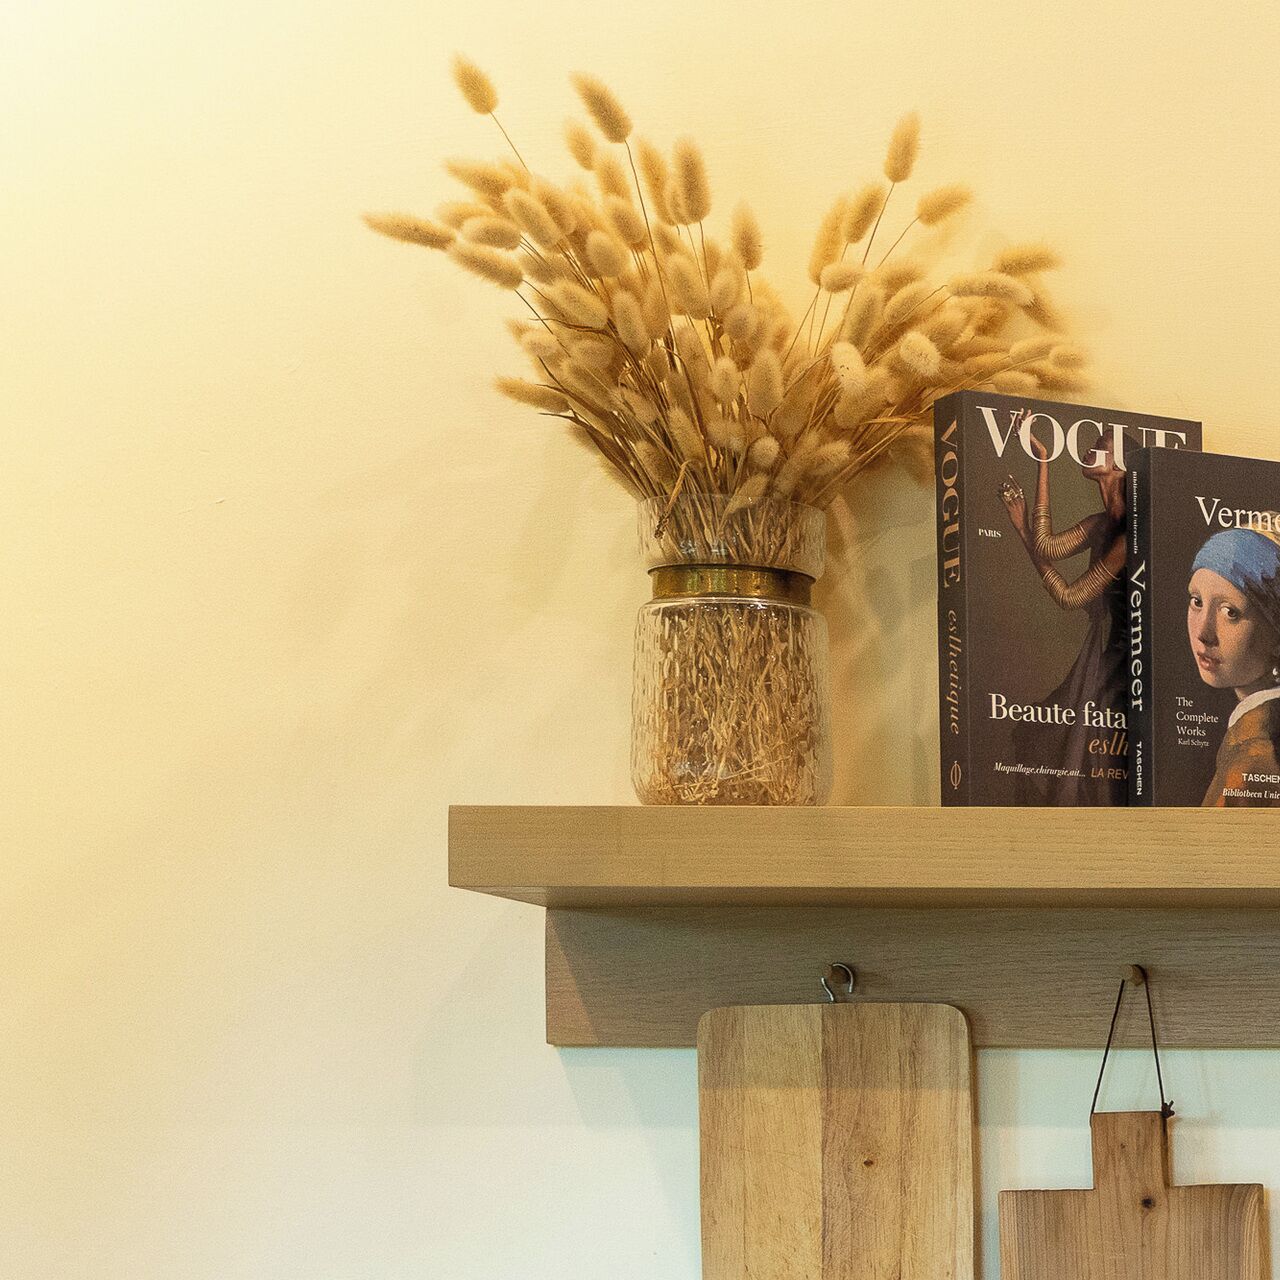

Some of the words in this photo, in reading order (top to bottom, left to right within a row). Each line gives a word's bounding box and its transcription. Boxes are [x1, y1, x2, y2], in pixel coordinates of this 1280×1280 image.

[941, 420, 961, 589] VOGUE
[978, 528, 1002, 540] PARIS
[1129, 560, 1147, 712] Vermeer
[1176, 696, 1194, 708] The
[988, 693, 1076, 726] Beaute
[1176, 711, 1219, 725] Complete
[1176, 725, 1207, 737] Works
[1091, 767, 1105, 779] LA
